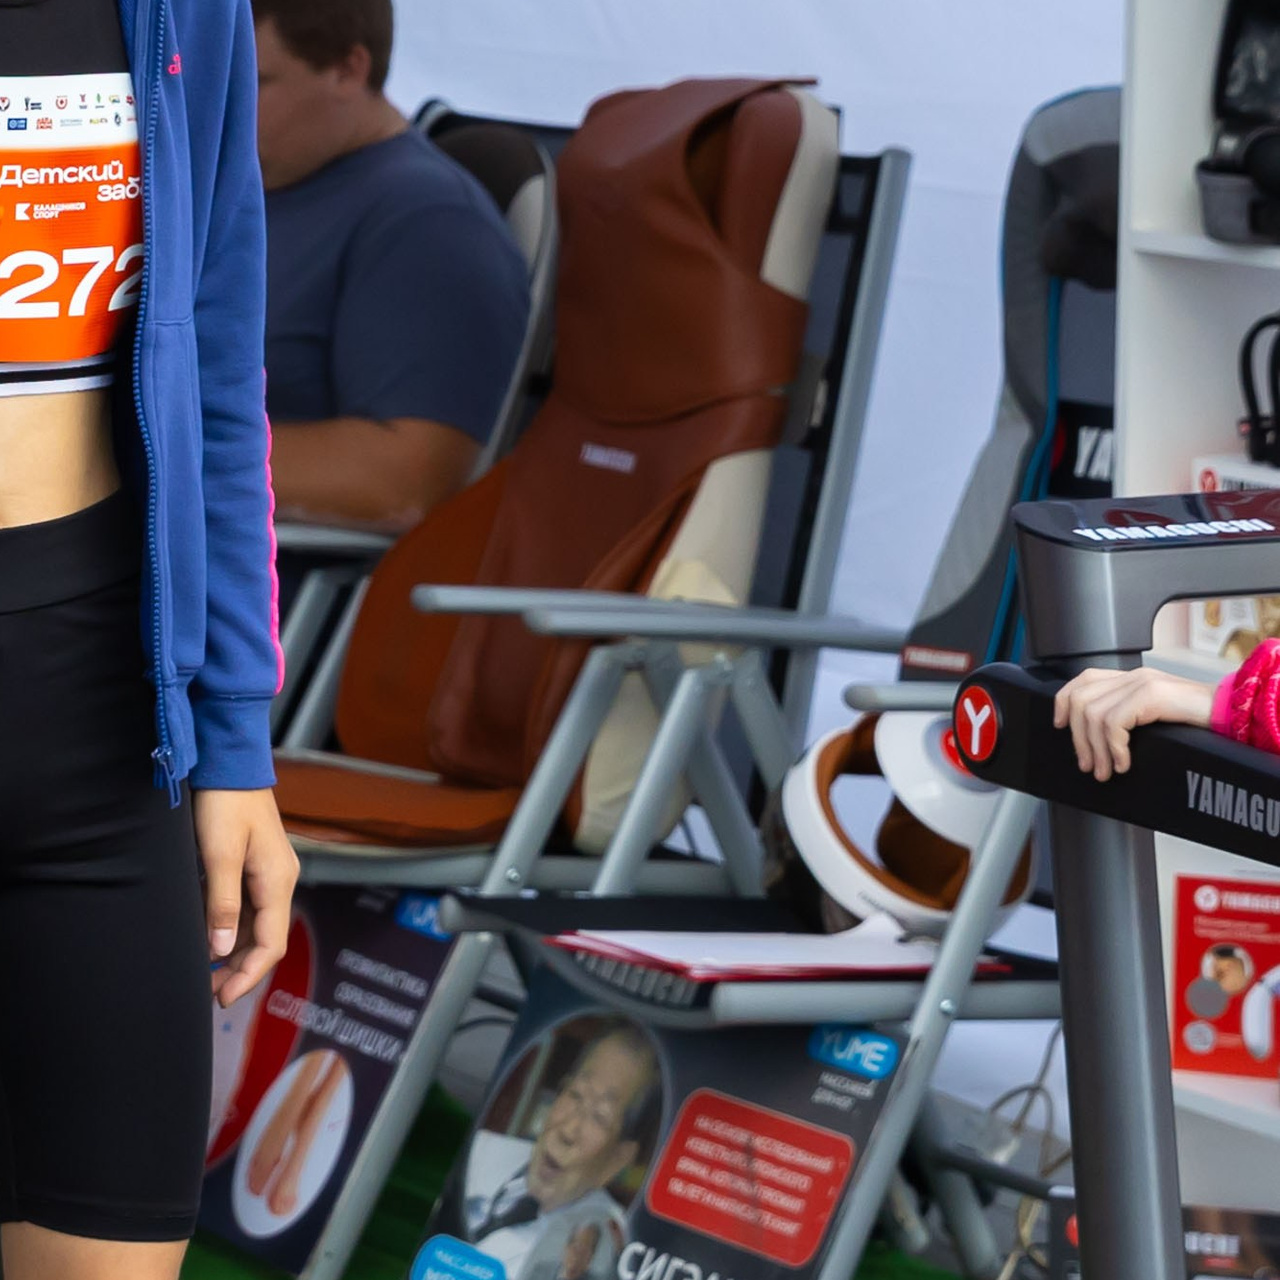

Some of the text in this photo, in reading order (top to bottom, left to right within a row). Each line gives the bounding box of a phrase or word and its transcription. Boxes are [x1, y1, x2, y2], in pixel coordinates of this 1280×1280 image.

[97, 177, 142, 202] заб
[1073, 518, 1275, 541] YAMAGUCHI
[821, 1030, 889, 1072] YUME
